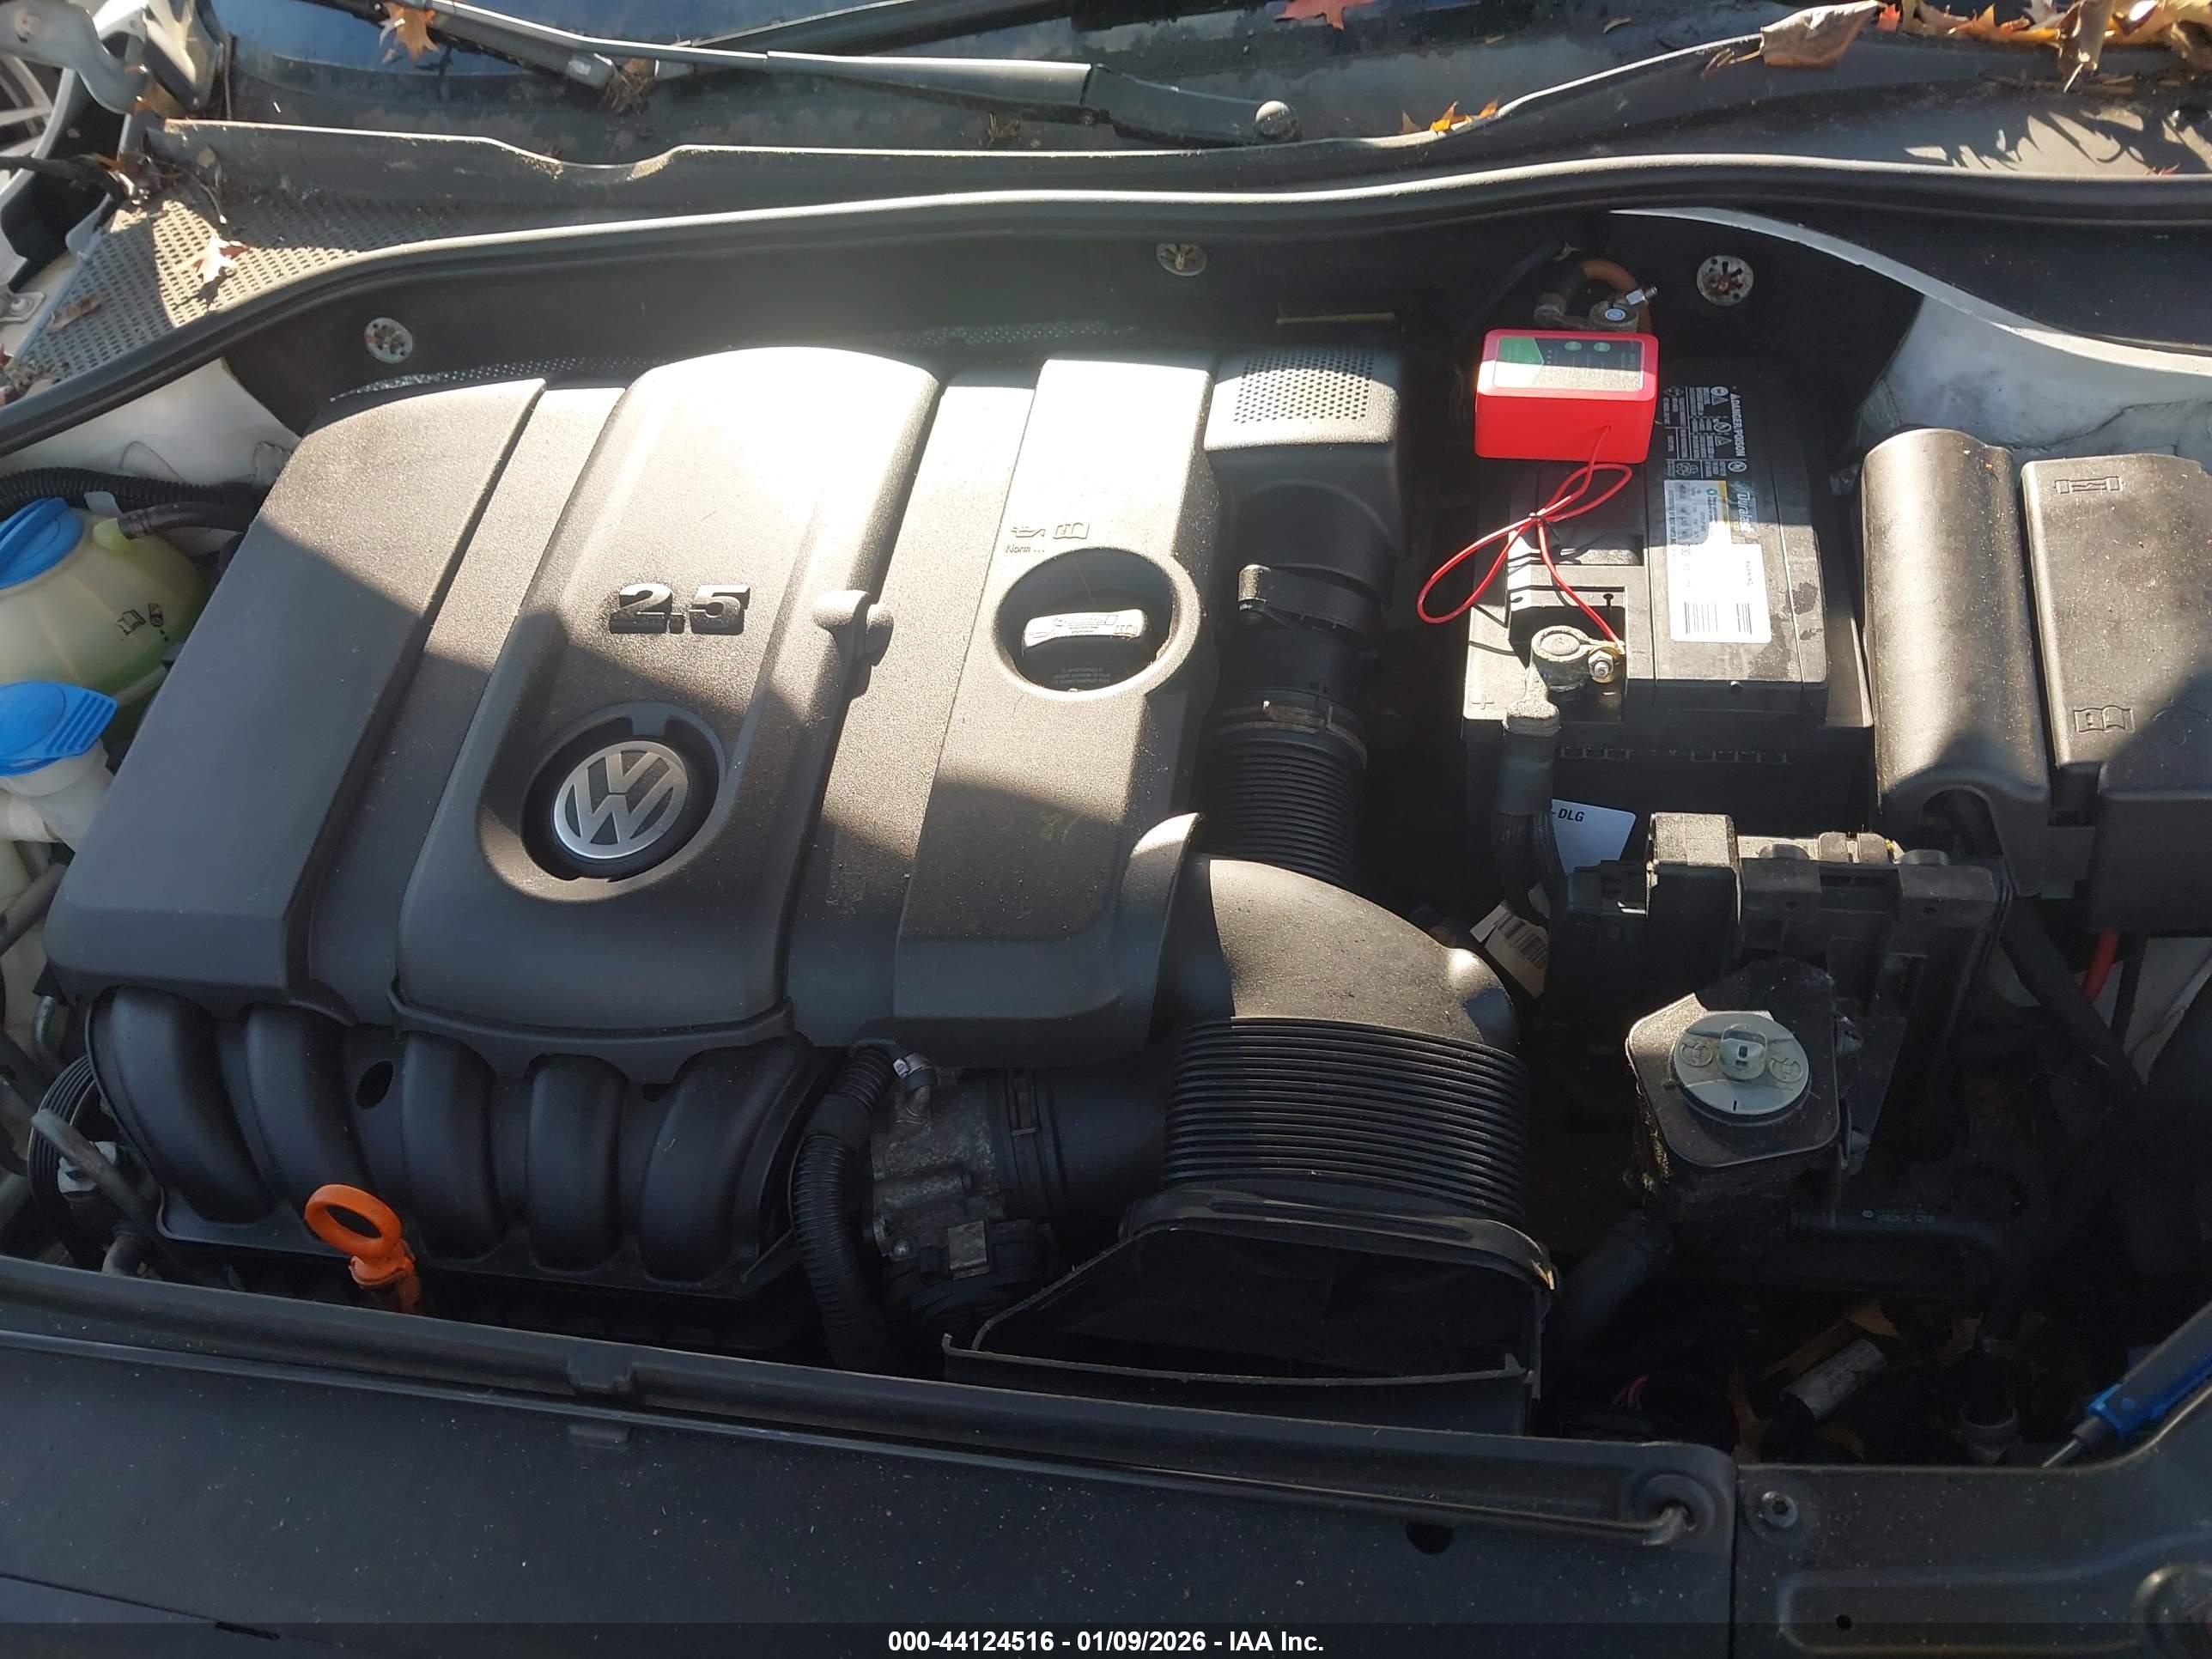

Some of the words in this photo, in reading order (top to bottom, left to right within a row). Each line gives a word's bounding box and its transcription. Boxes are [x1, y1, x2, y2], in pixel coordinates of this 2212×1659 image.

[1731, 399, 1742, 429] DANGER
[1734, 429, 1746, 457] POISON
[609, 583, 750, 635] 2.5
